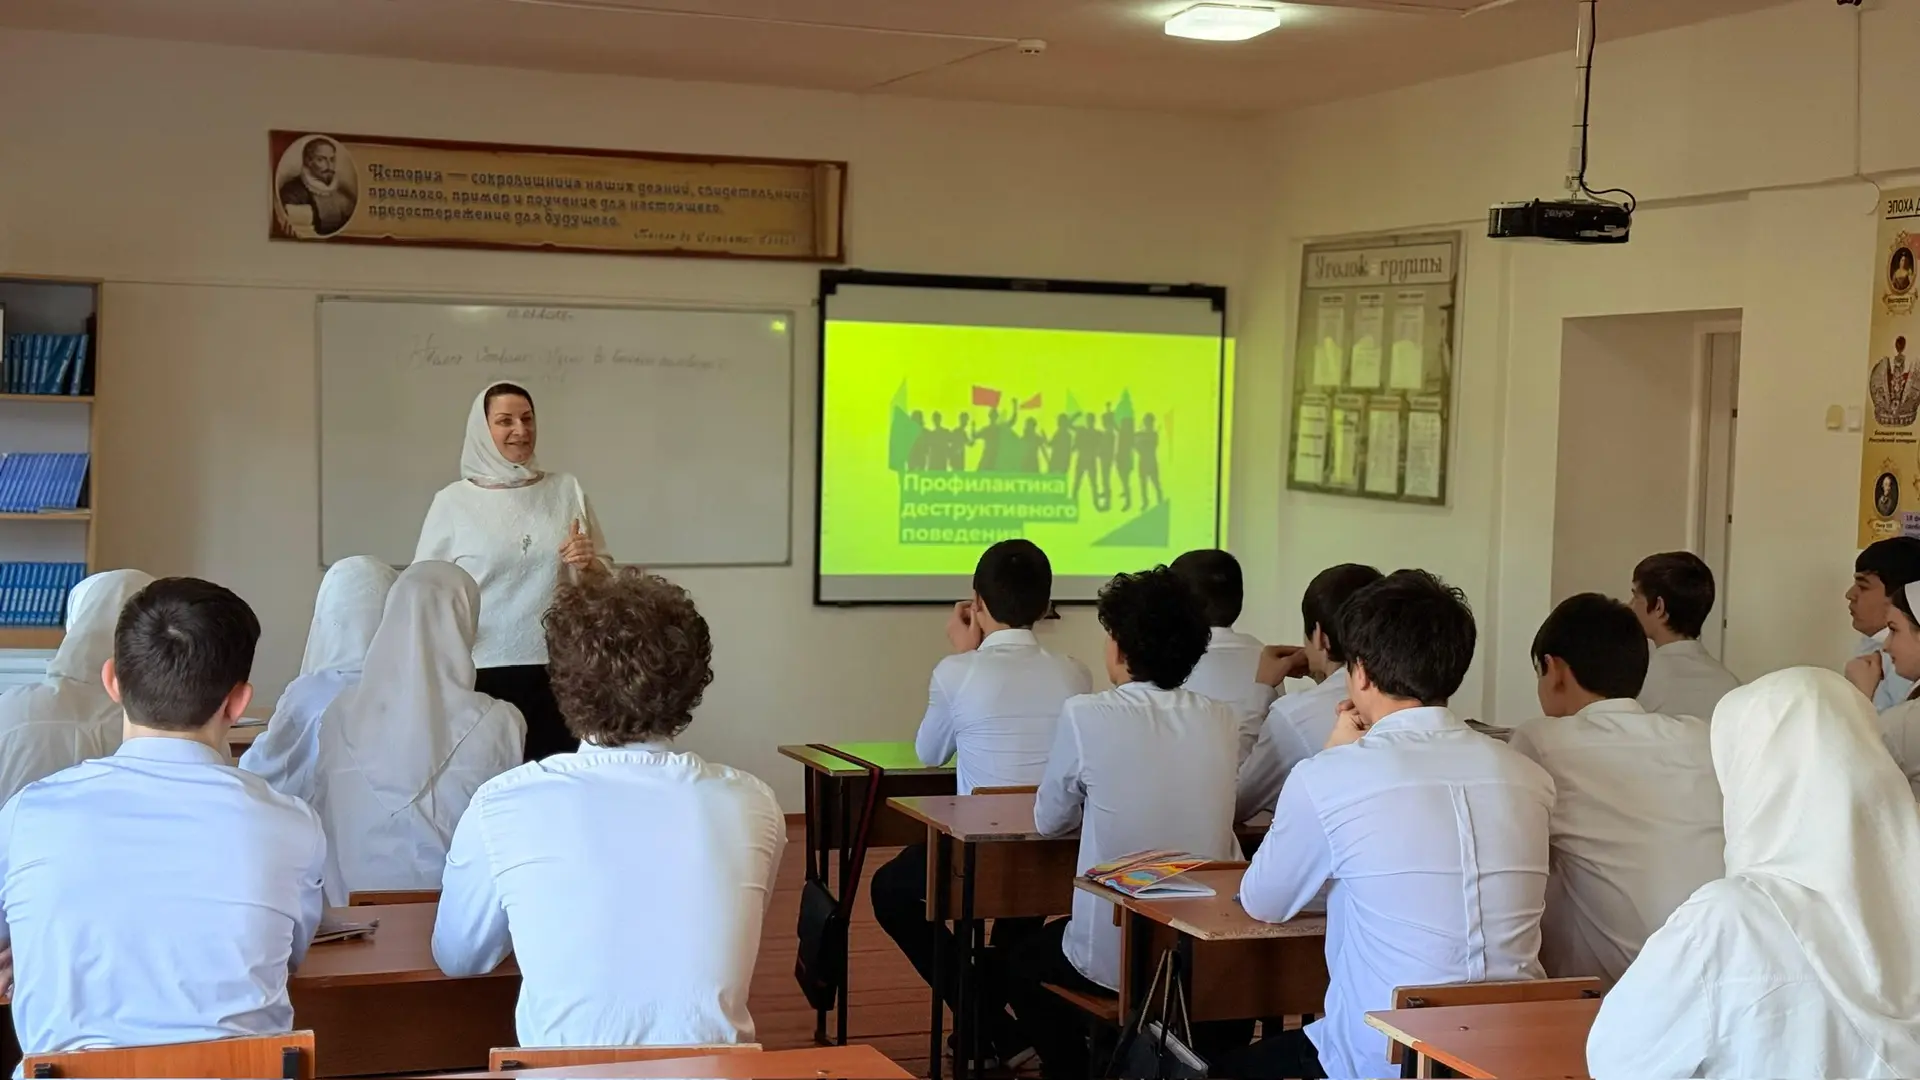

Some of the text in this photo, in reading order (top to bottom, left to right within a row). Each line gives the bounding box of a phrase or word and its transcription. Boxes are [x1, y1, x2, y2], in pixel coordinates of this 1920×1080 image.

[368, 163, 443, 184] История
[471, 171, 582, 191] сокровищница
[585, 179, 635, 193] наших
[368, 186, 448, 203] прошлого,
[452, 189, 510, 206] пример
[513, 193, 522, 204] и
[526, 193, 597, 210] поучение
[600, 197, 626, 212] для
[1887, 198, 1914, 214] ЭПОХА
[368, 203, 510, 223] предостережение
[514, 210, 541, 226] для
[1315, 253, 1442, 283] Уголок группы
[903, 473, 1066, 496] Профилактика
[901, 501, 1077, 521] деструктивного
